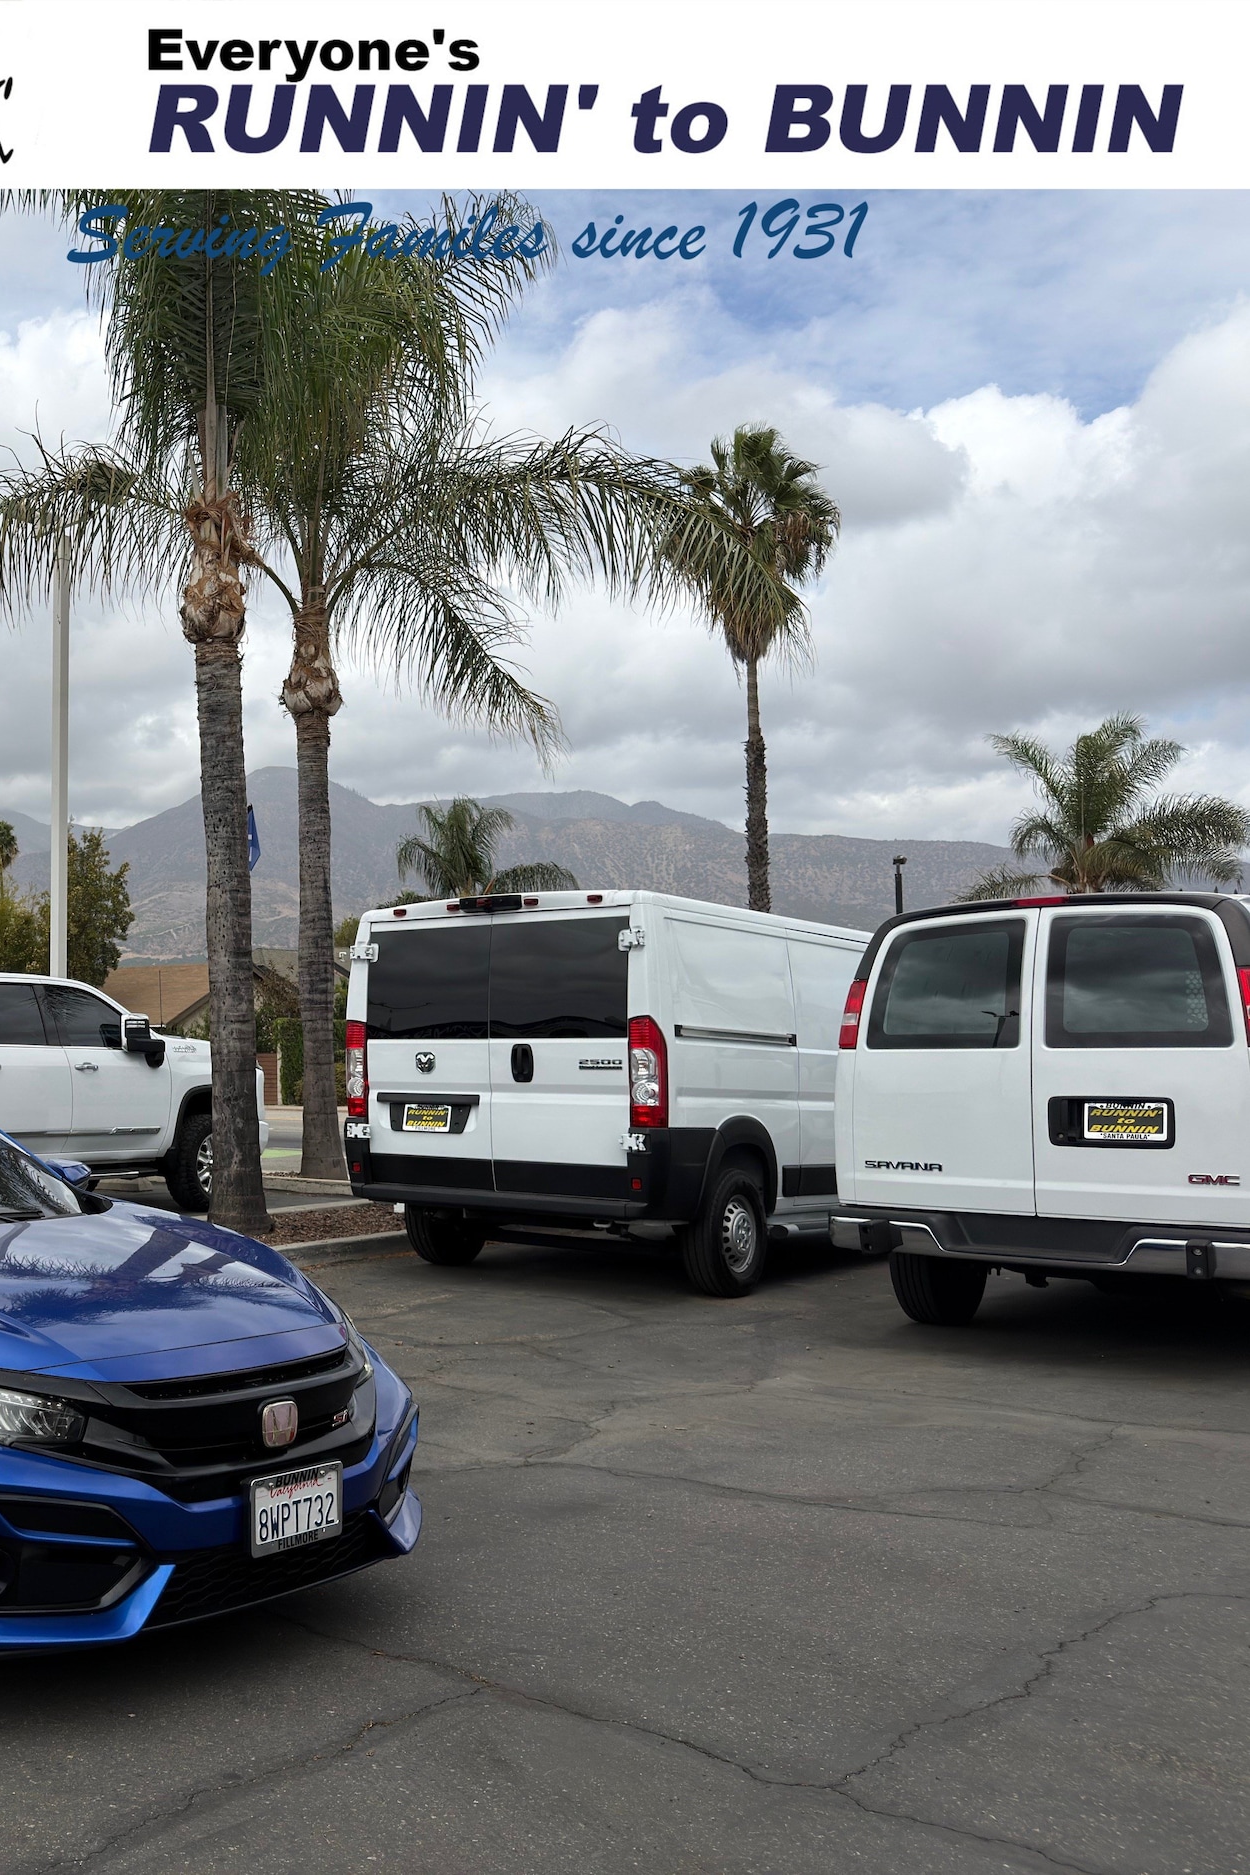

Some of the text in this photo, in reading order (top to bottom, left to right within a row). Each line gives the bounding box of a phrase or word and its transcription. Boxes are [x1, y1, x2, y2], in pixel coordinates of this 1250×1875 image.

[1090, 1124, 1159, 1133] BUNNIN
[865, 1160, 943, 1172] SAVANA
[1188, 1173, 1240, 1186] GMC
[276, 1467, 320, 1488] BUNNIN
[259, 1491, 335, 1542] 8WPT732
[278, 1530, 319, 1551] FILLMORE
